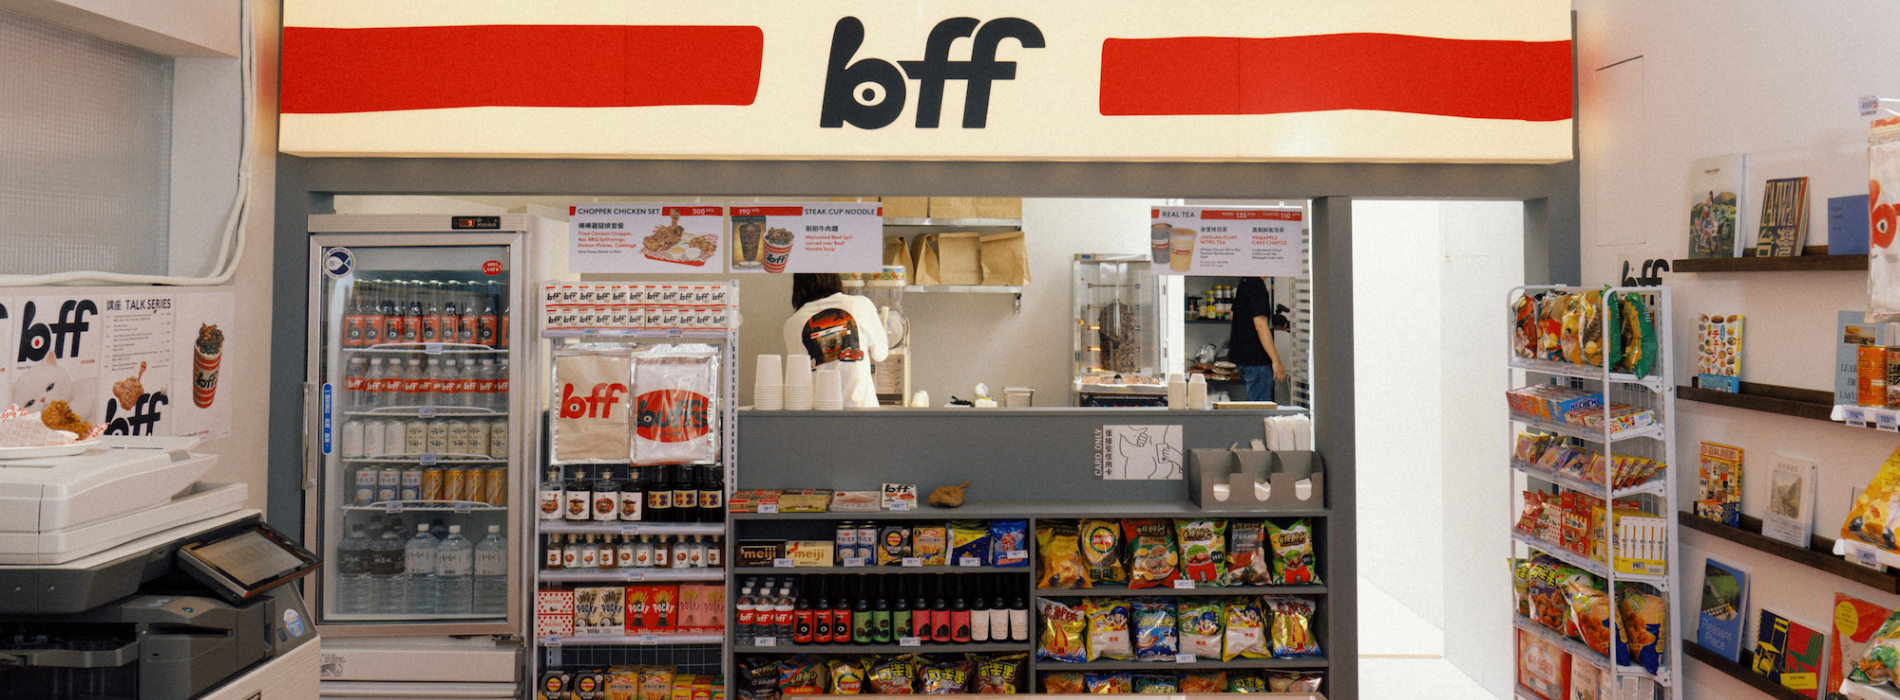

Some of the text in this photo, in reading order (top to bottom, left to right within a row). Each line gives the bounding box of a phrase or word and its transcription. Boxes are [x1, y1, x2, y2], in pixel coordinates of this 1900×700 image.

[820, 16, 1045, 130] bff
[126, 299, 146, 310] TALK
[147, 298, 171, 310] SERIES
[1841, 364, 1857, 372] LEAR
[744, 547, 776, 560] meiji
[794, 548, 824, 560] meiji
[1701, 618, 1732, 642] Pleasant
[1704, 632, 1725, 651] Place
